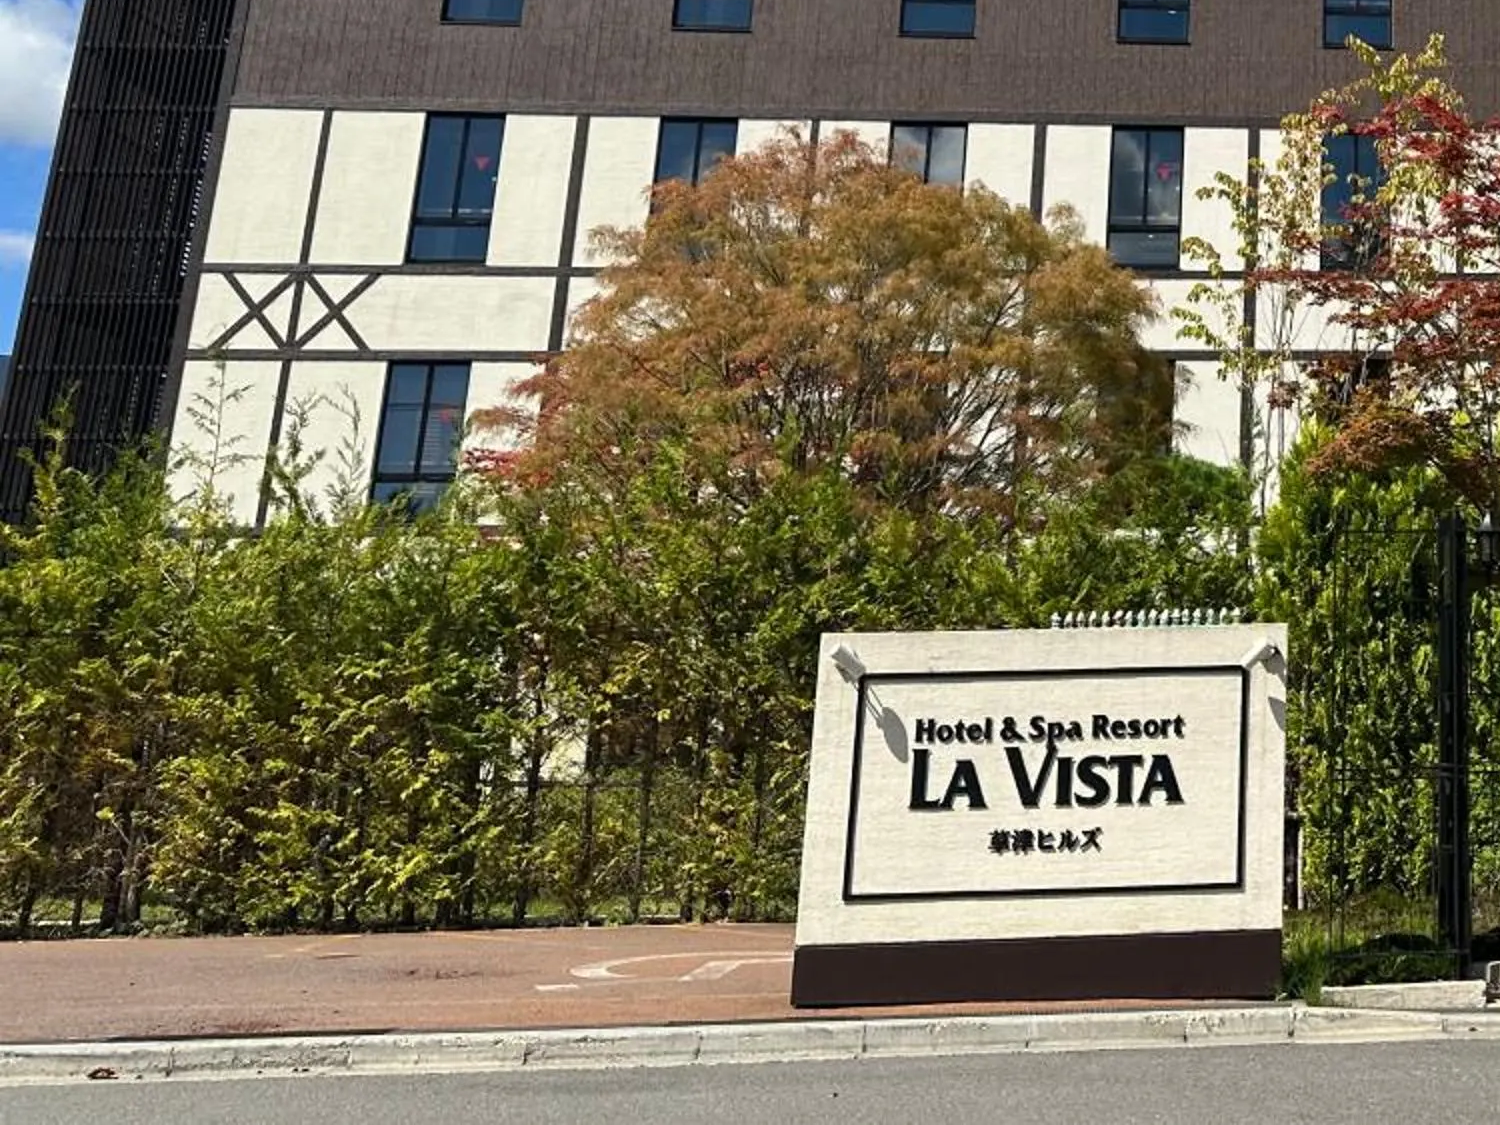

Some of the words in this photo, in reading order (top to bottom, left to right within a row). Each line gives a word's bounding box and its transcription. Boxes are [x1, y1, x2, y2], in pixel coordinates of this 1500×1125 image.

[915, 717, 993, 743] Hotel
[1000, 717, 1026, 741] &
[1029, 715, 1084, 745] Spa
[1092, 714, 1186, 739] Resort
[909, 748, 988, 811] LA
[1004, 745, 1185, 808] VISTA
[989, 827, 1103, 855] 草津ヒルズ
